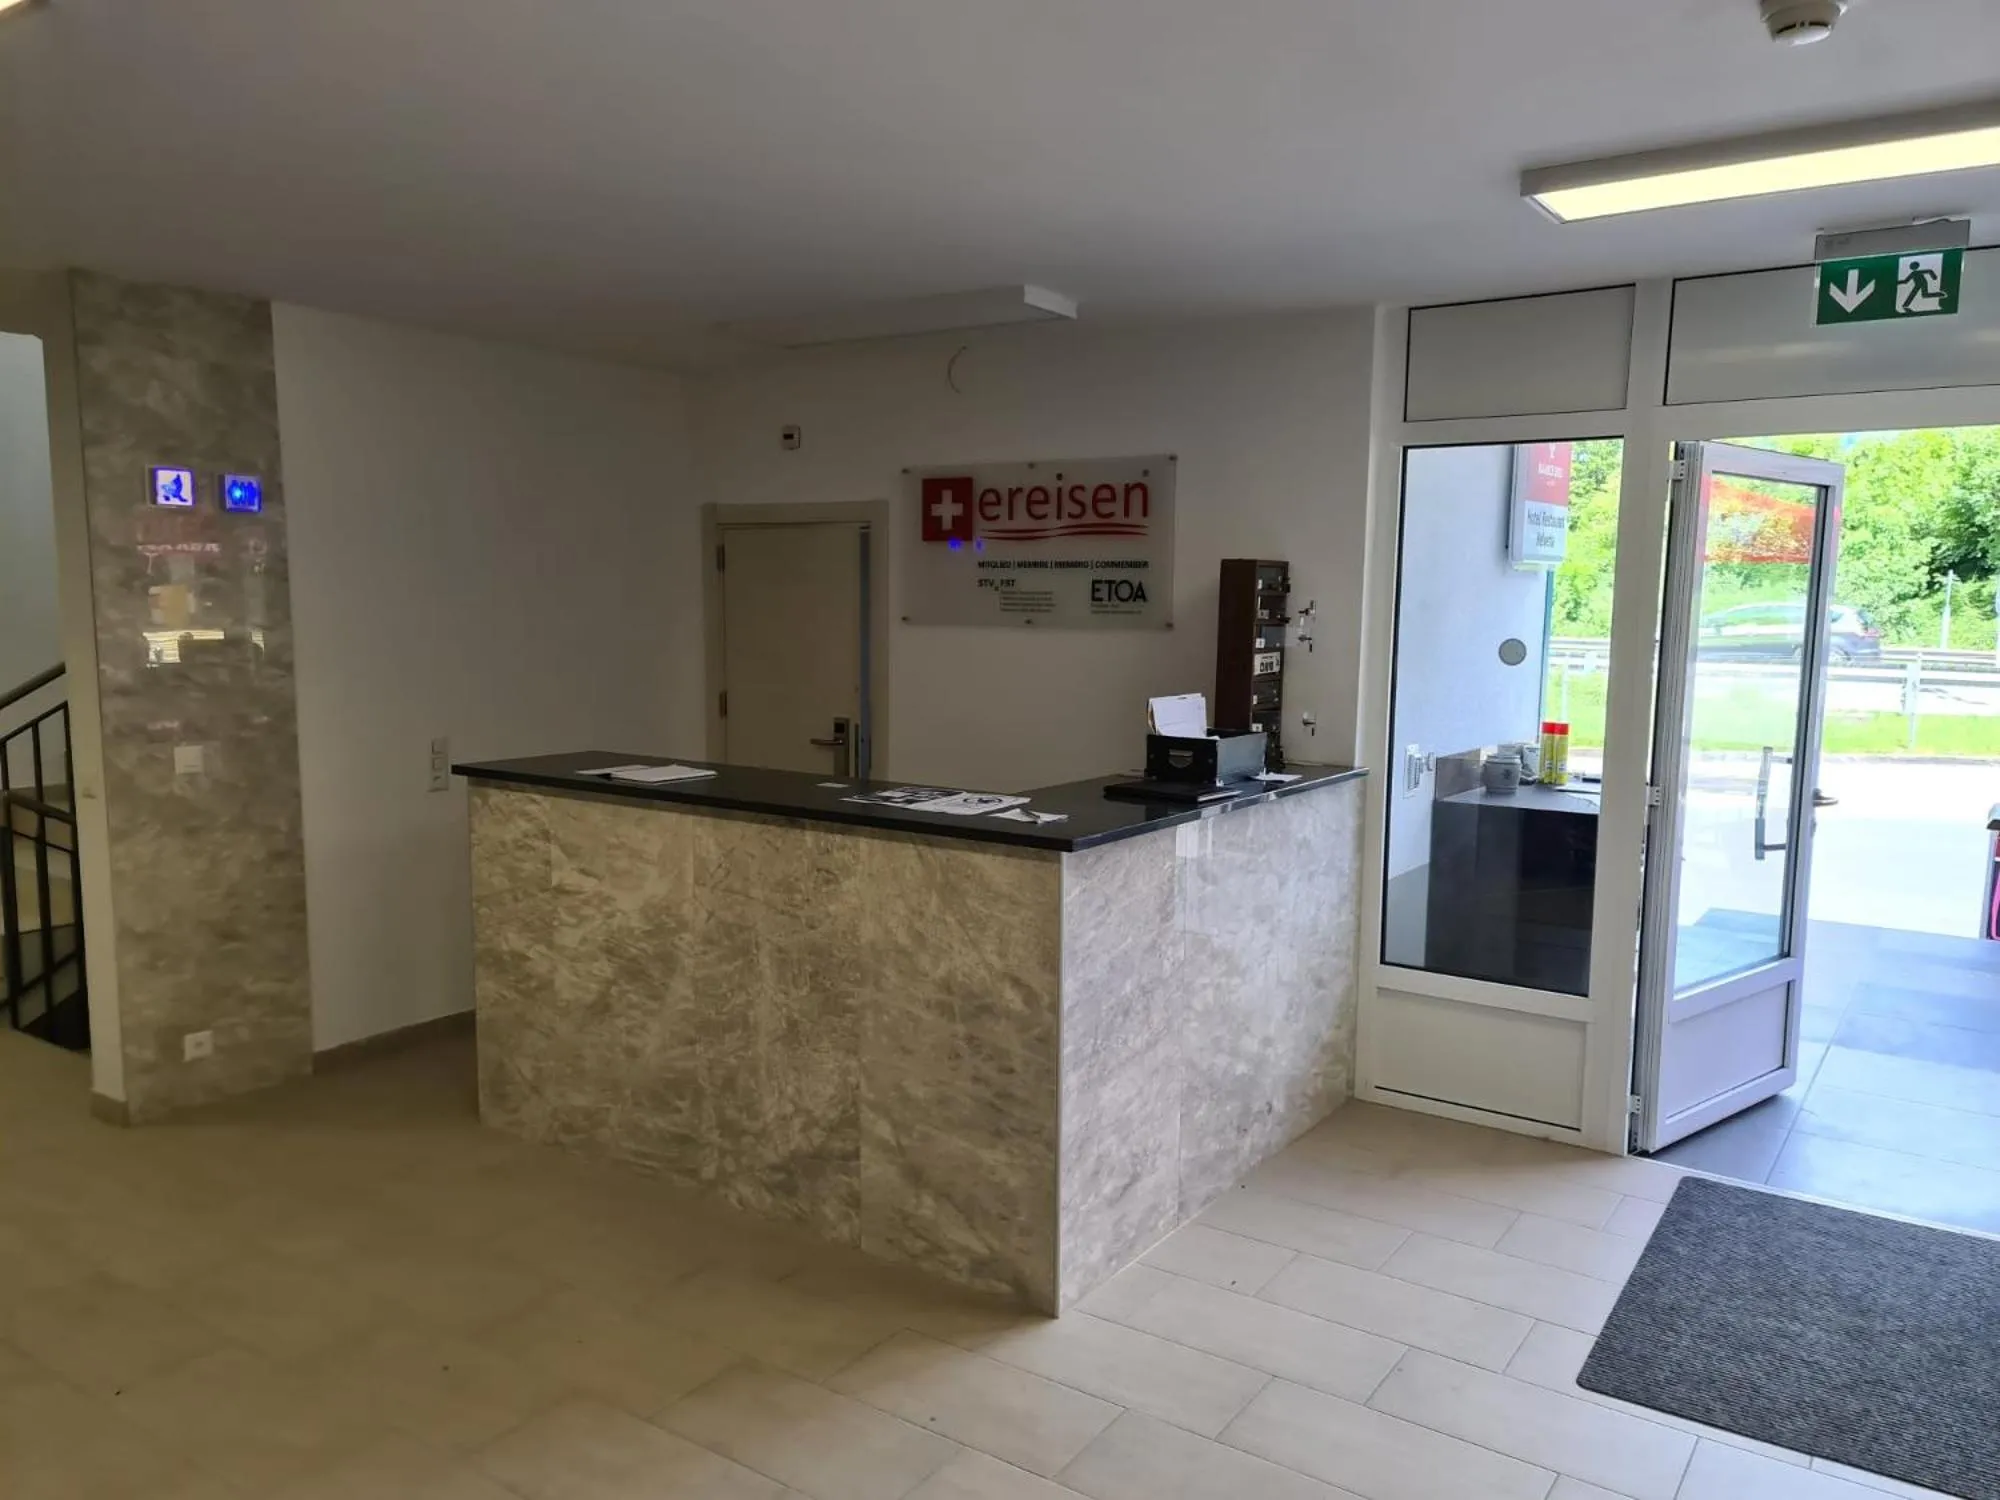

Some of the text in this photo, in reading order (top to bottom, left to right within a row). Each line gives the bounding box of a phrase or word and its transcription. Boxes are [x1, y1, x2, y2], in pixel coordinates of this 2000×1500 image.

[979, 473, 1148, 521] ereisen
[977, 579, 994, 588] STV
[1091, 579, 1147, 602] ETOA
